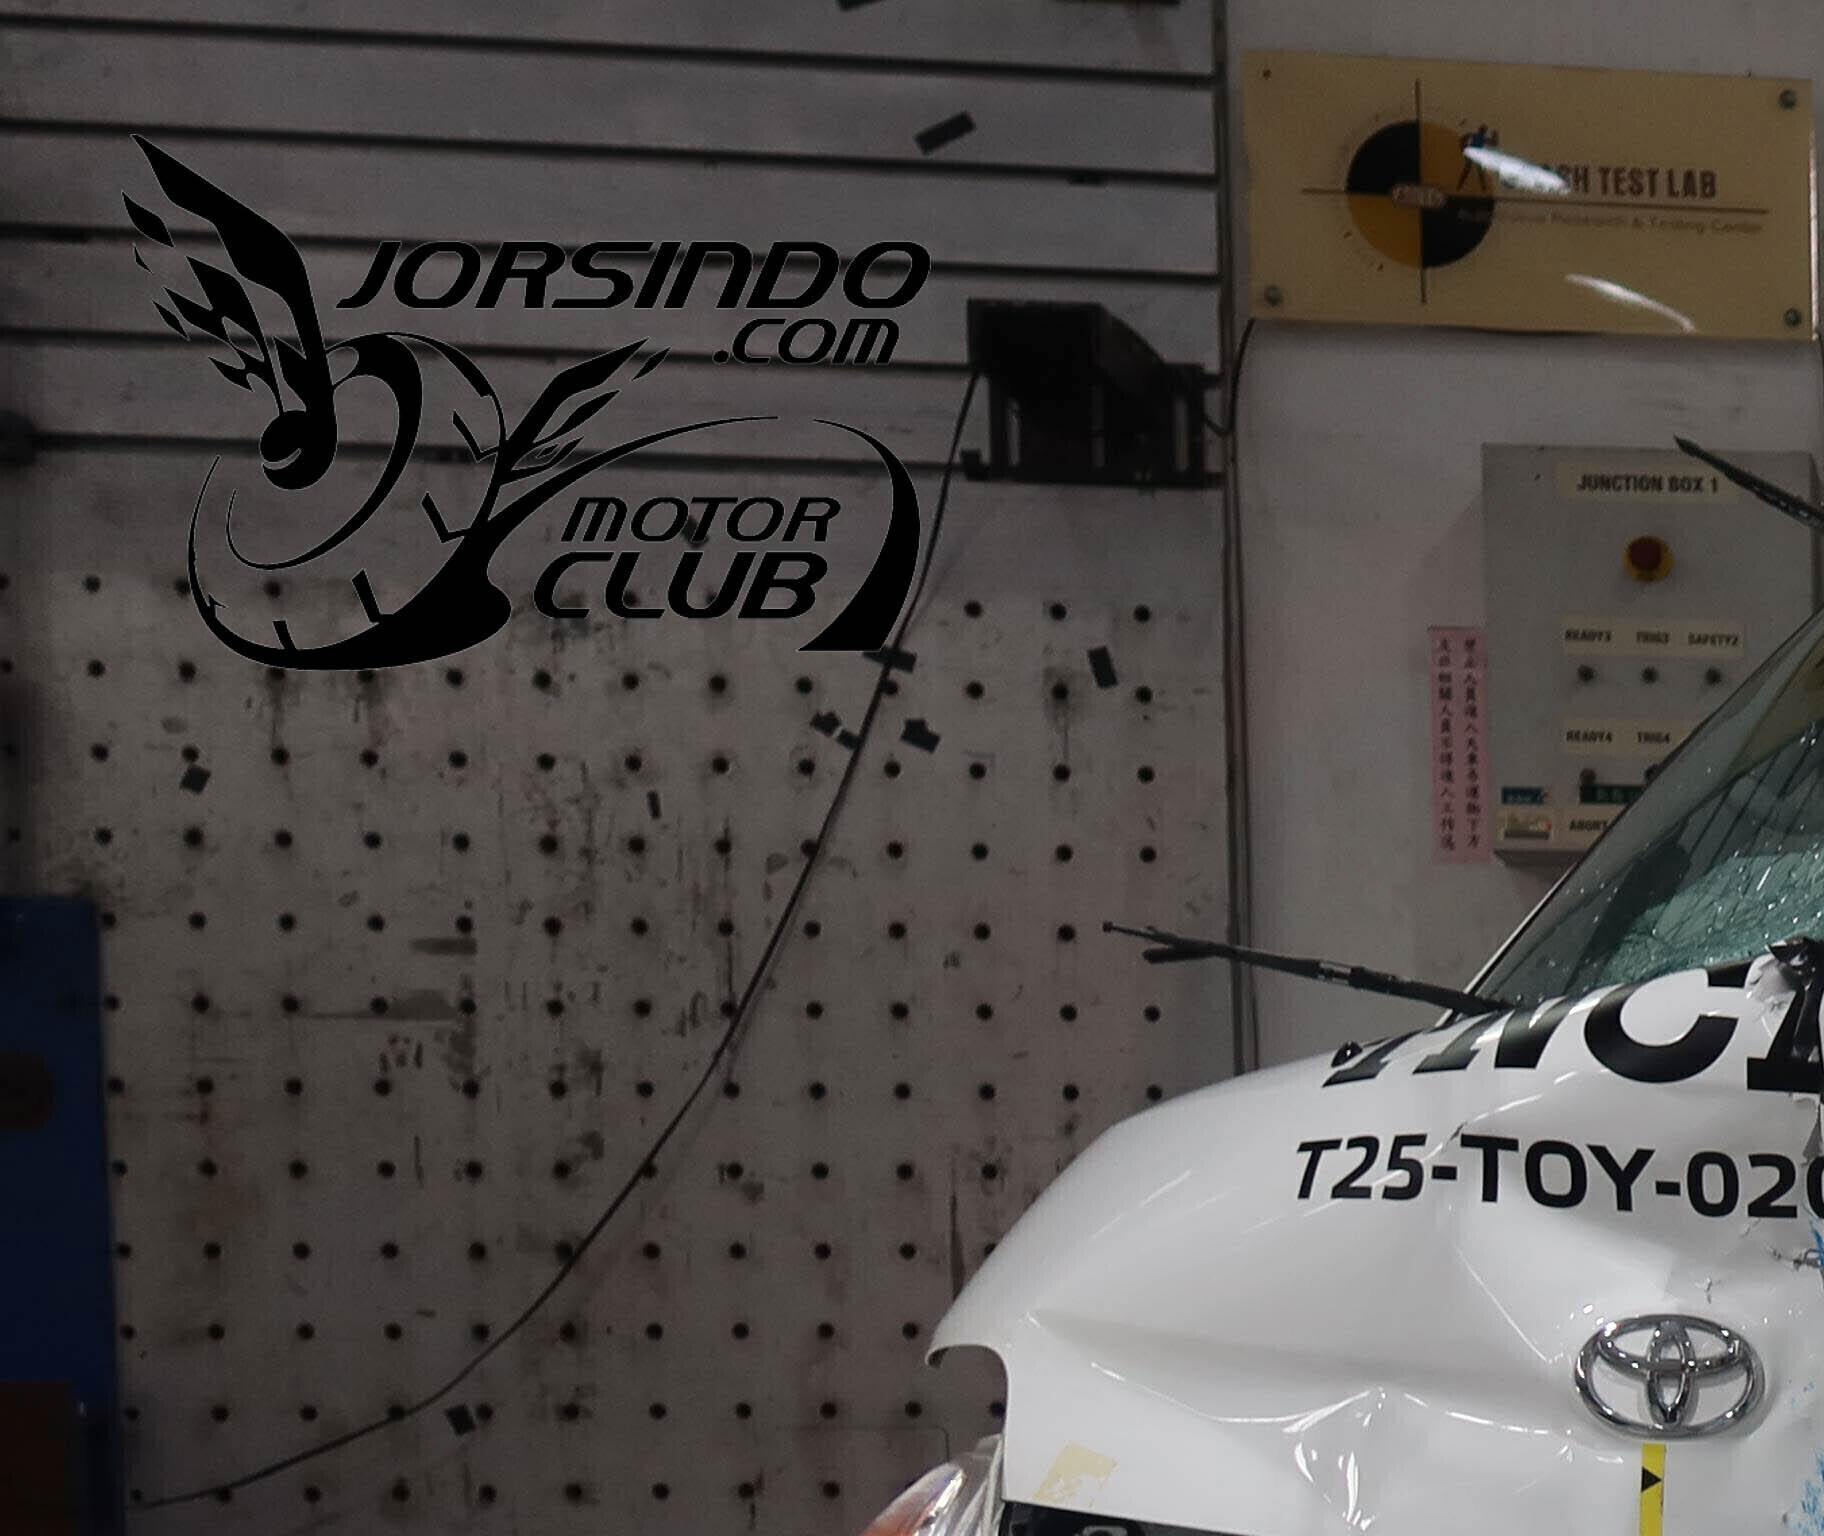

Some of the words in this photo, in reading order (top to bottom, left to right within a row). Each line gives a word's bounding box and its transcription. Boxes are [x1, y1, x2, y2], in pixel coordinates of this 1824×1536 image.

[1598, 166, 1660, 197] TEST
[1667, 168, 1718, 200] LAB
[1576, 473, 1663, 494] JUNCTION
[1667, 475, 1705, 494] BOX
[1709, 476, 1718, 494] 1
